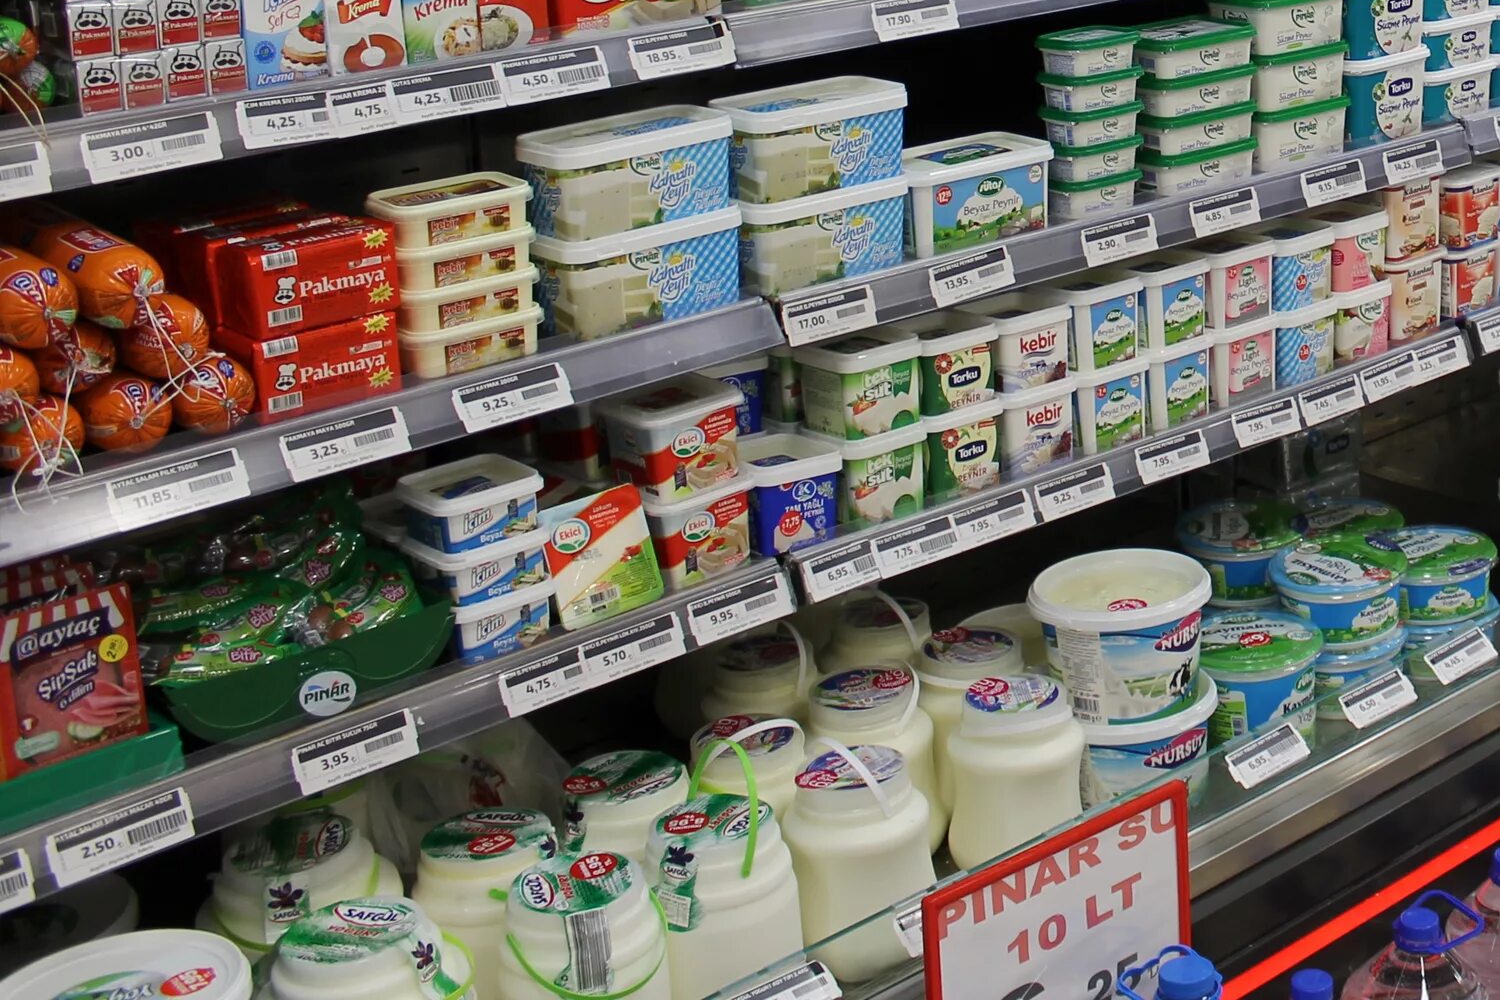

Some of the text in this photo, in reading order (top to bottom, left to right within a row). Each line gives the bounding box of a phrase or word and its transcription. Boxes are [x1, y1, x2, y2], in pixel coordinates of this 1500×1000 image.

[348, 0, 381, 20] Krema
[885, 15, 912, 26] 17.90
[257, 72, 295, 86] Krema
[522, 74, 549, 88] 4,50
[414, 92, 441, 106] 4,25
[354, 105, 382, 118] 4,75
[267, 115, 296, 129] 4,25
[831, 130, 872, 159] Kahvaltı
[111, 146, 144, 162] 3,00
[651, 160, 697, 194] Kahvaltı
[659, 179, 691, 208] Keyfi
[979, 179, 1003, 193] sütaş
[963, 195, 1019, 217] Beyaz Peynir
[432, 218, 459, 231] kebir
[635, 251, 659, 264] PINAR
[300, 268, 386, 297] Pakmaya
[659, 271, 691, 303] Keyfi
[945, 276, 968, 290] 13,95
[1238, 276, 1257, 290] Light
[1019, 332, 1057, 354] kebir
[300, 353, 386, 383] Pakmaya
[951, 368, 979, 385] Torku
[482, 396, 509, 412] 9,25
[678, 433, 698, 446] Ekici
[309, 443, 339, 460] 3,25
[958, 443, 985, 459] Torku
[132, 489, 172, 509] 11,85
[800, 498, 825, 511] YAĞLI
[1052, 492, 1071, 505] 9,25
[462, 509, 494, 535] İçim
[970, 519, 989, 533] 7,95
[559, 526, 582, 541] Ekici
[827, 566, 848, 581] 6,95
[17, 615, 101, 658] @aytaç
[230, 648, 261, 663] Bitir
[38, 650, 99, 700] ŞipŞak
[69, 681, 94, 705] dilim
[303, 683, 351, 705] PINAR
[1150, 733, 1204, 768] NURSÜT
[1249, 756, 1268, 770] 6,95
[939, 799, 1176, 940] PINAR SU
[344, 907, 401, 924] SAFGÜL
[1007, 872, 1142, 965] 10 LT
